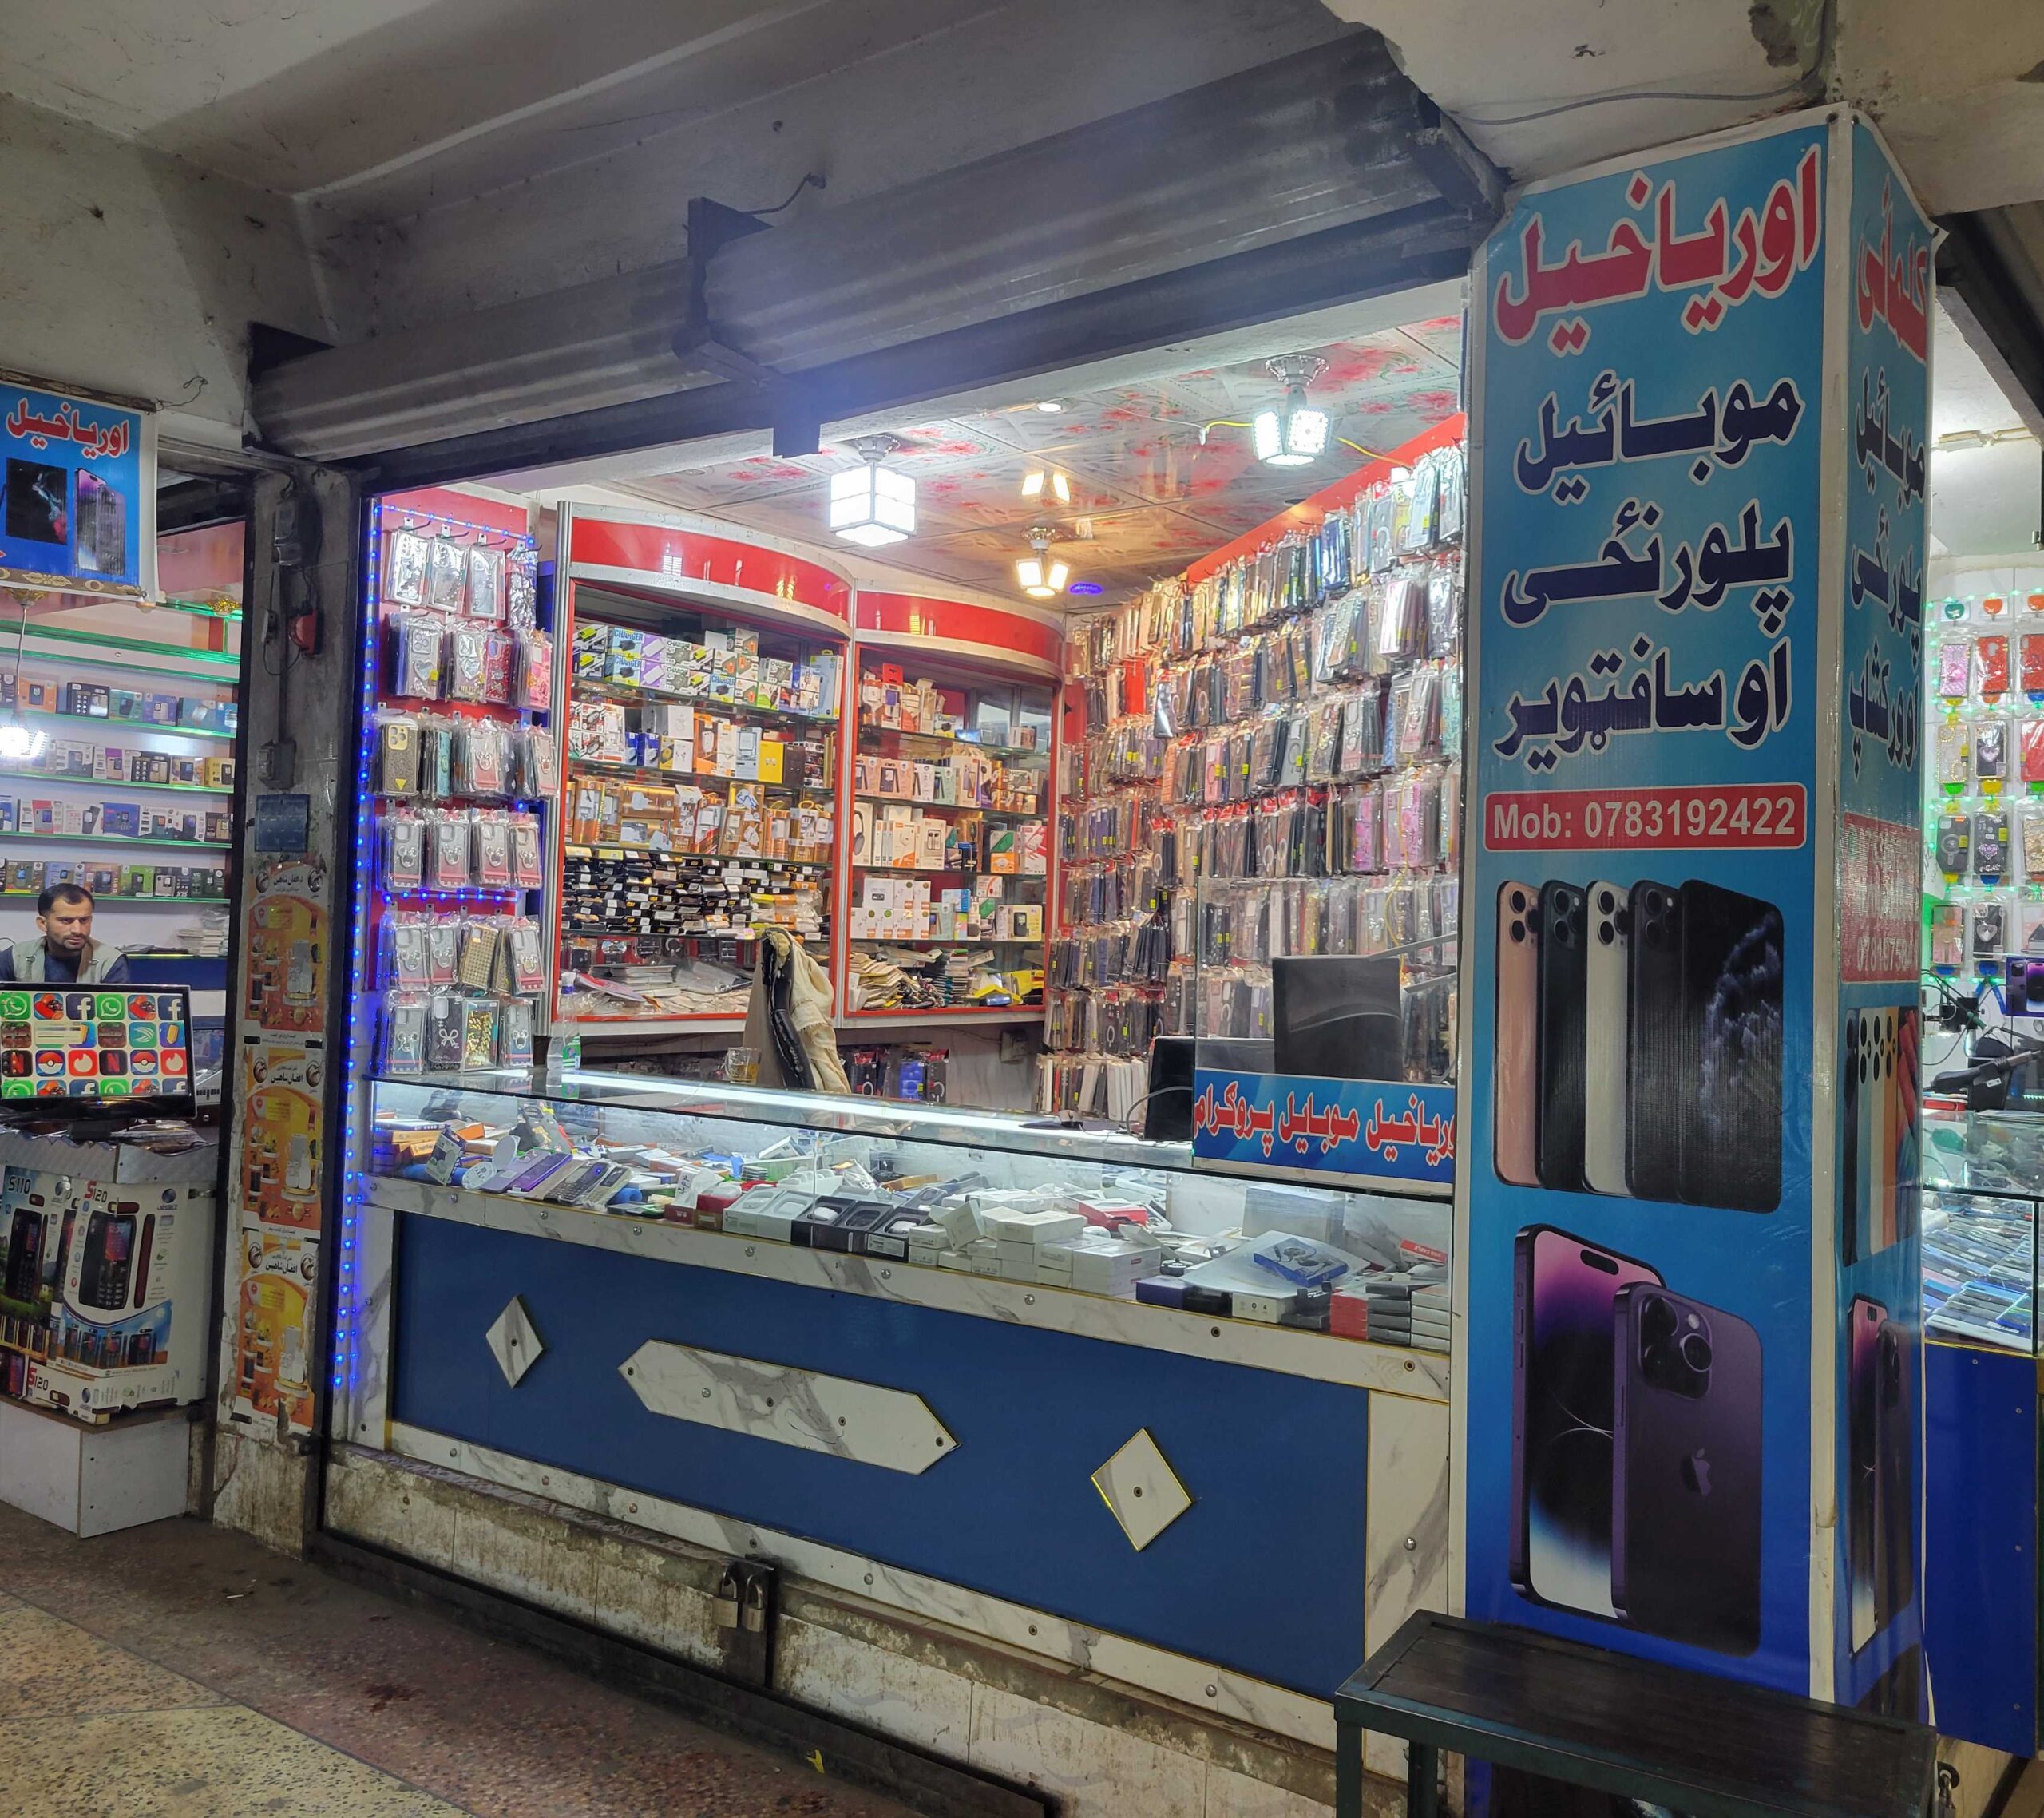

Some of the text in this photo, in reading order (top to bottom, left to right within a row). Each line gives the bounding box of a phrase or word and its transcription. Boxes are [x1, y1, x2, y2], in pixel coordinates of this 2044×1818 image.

[1494, 798, 1796, 839] Mob: 0783192422
[8, 1175, 32, 1195] S110
